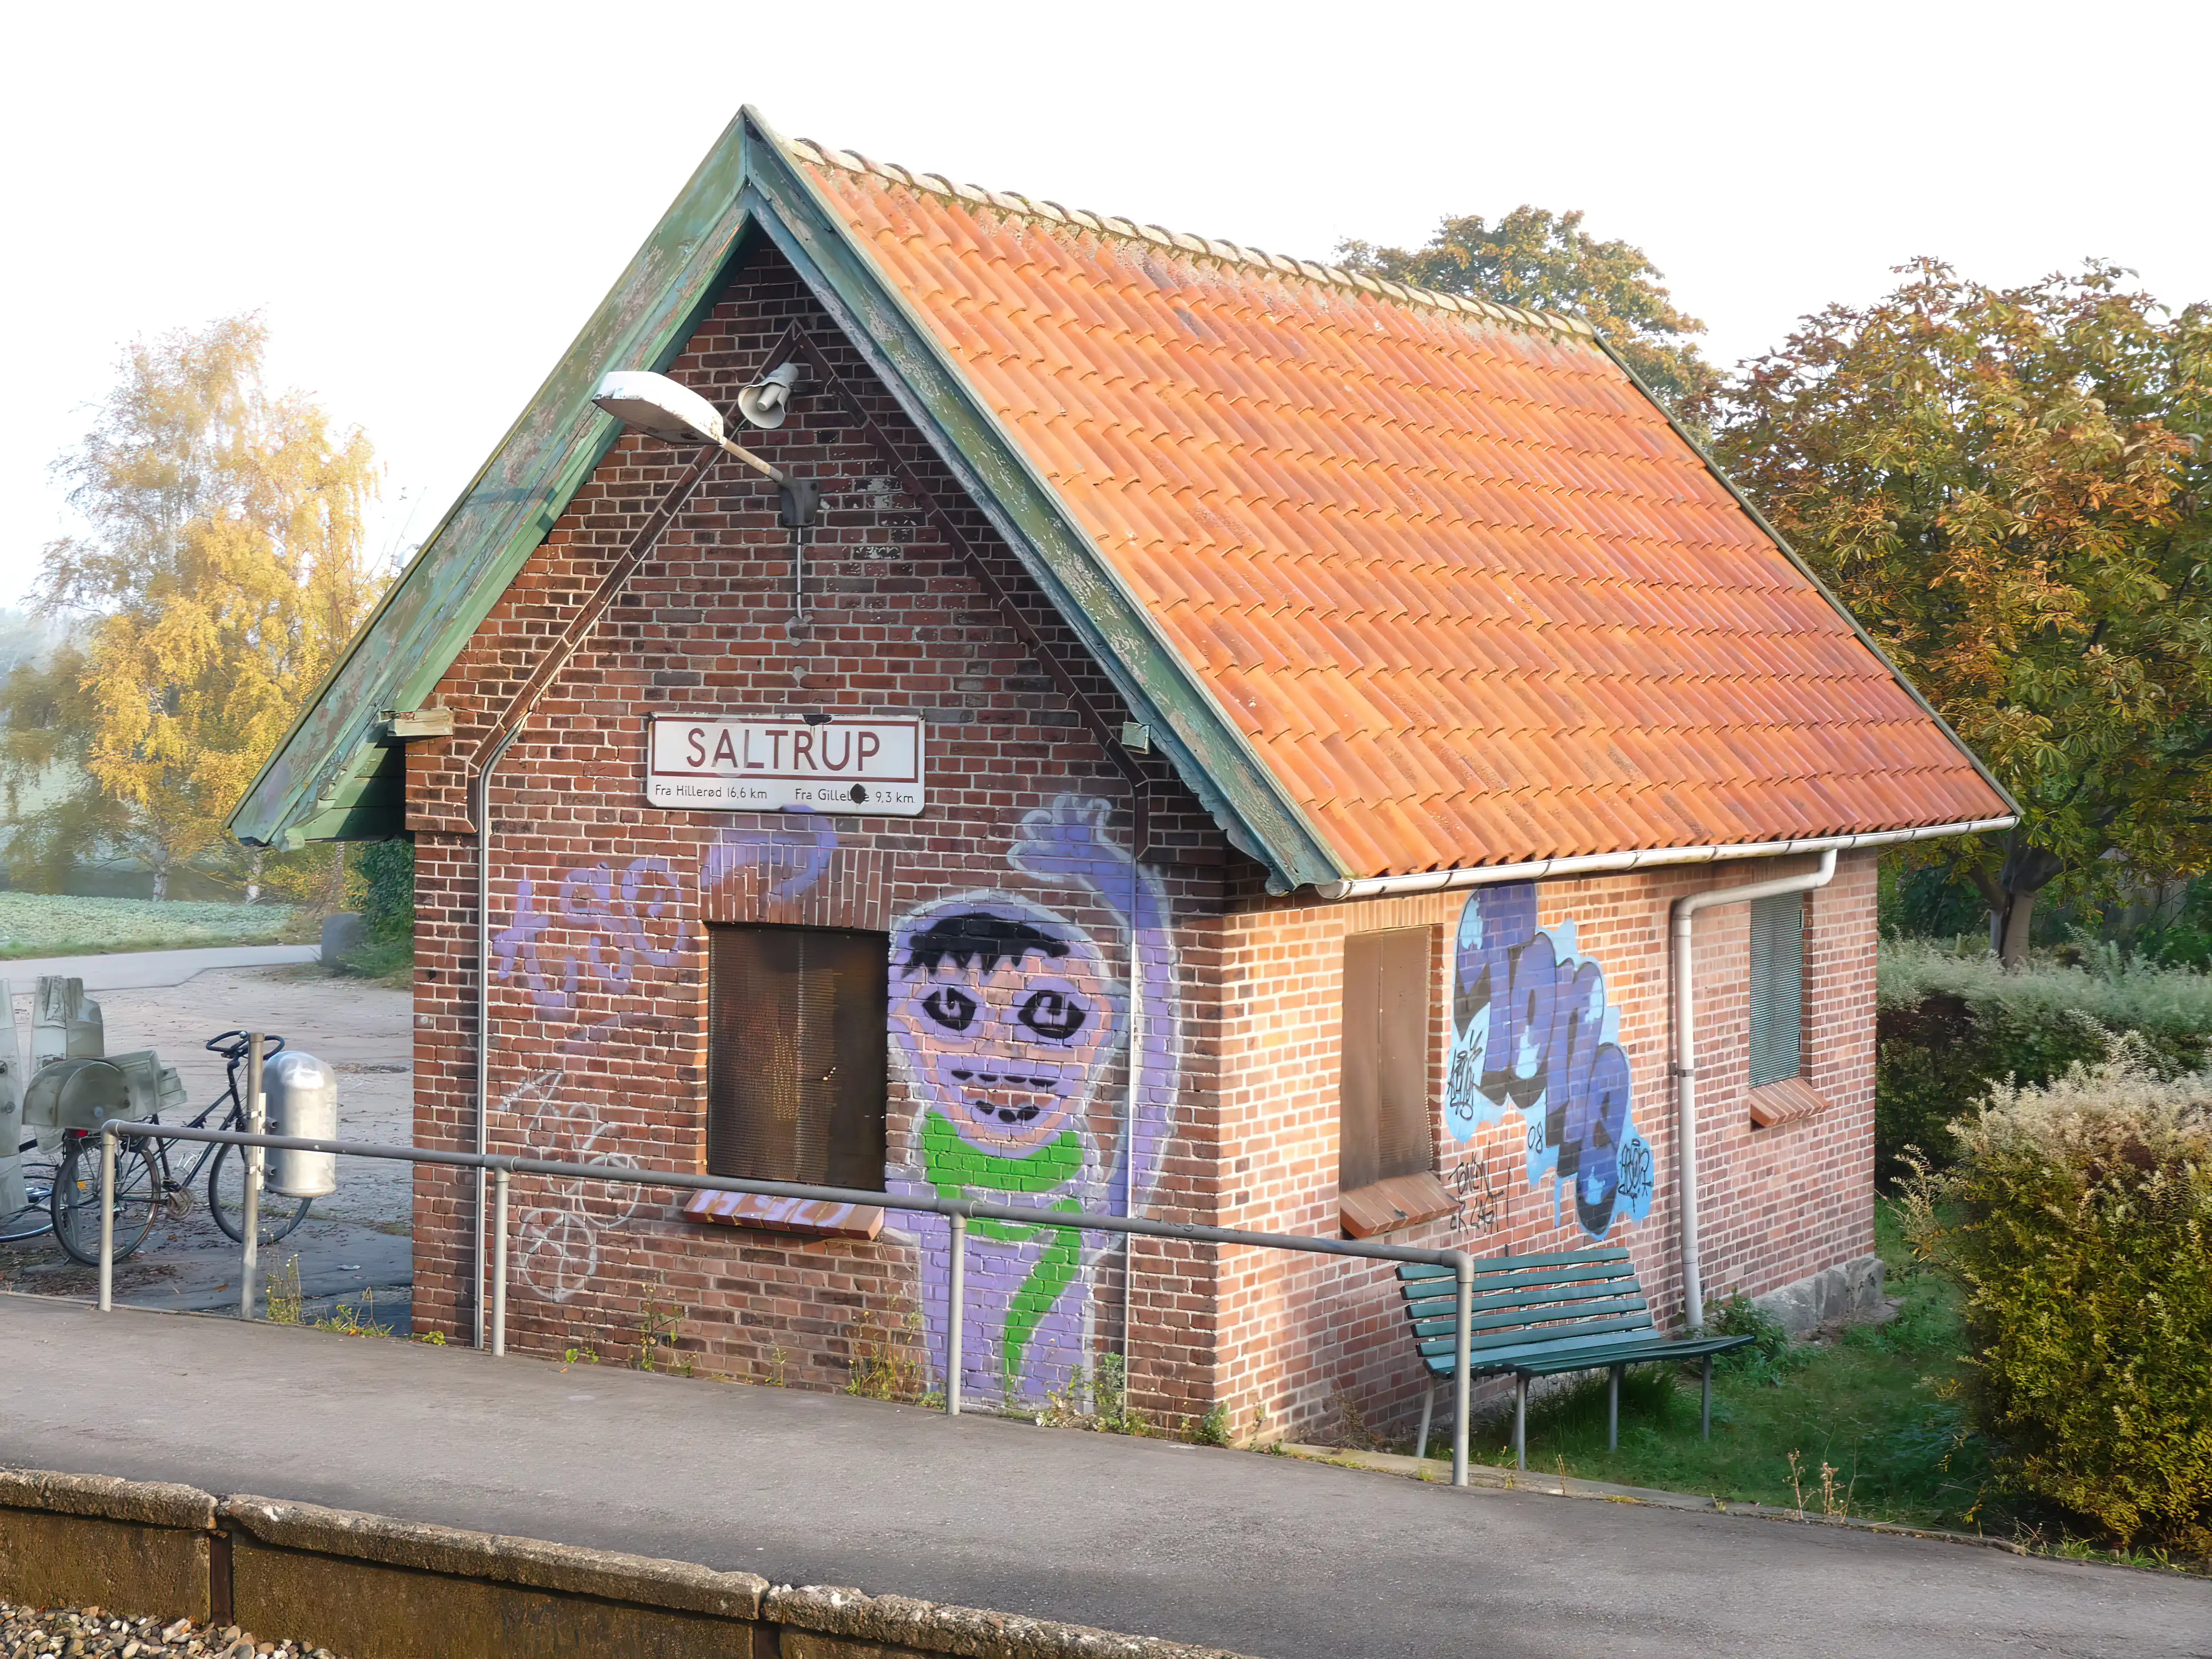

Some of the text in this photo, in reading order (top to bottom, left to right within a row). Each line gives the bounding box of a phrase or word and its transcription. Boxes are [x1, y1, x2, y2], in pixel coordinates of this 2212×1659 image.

[686, 727, 880, 772] SALTRUP
[655, 784, 768, 799] Fra Hillerød 16,6 km
[795, 788, 915, 803] Fra Gillele 9,3 km
